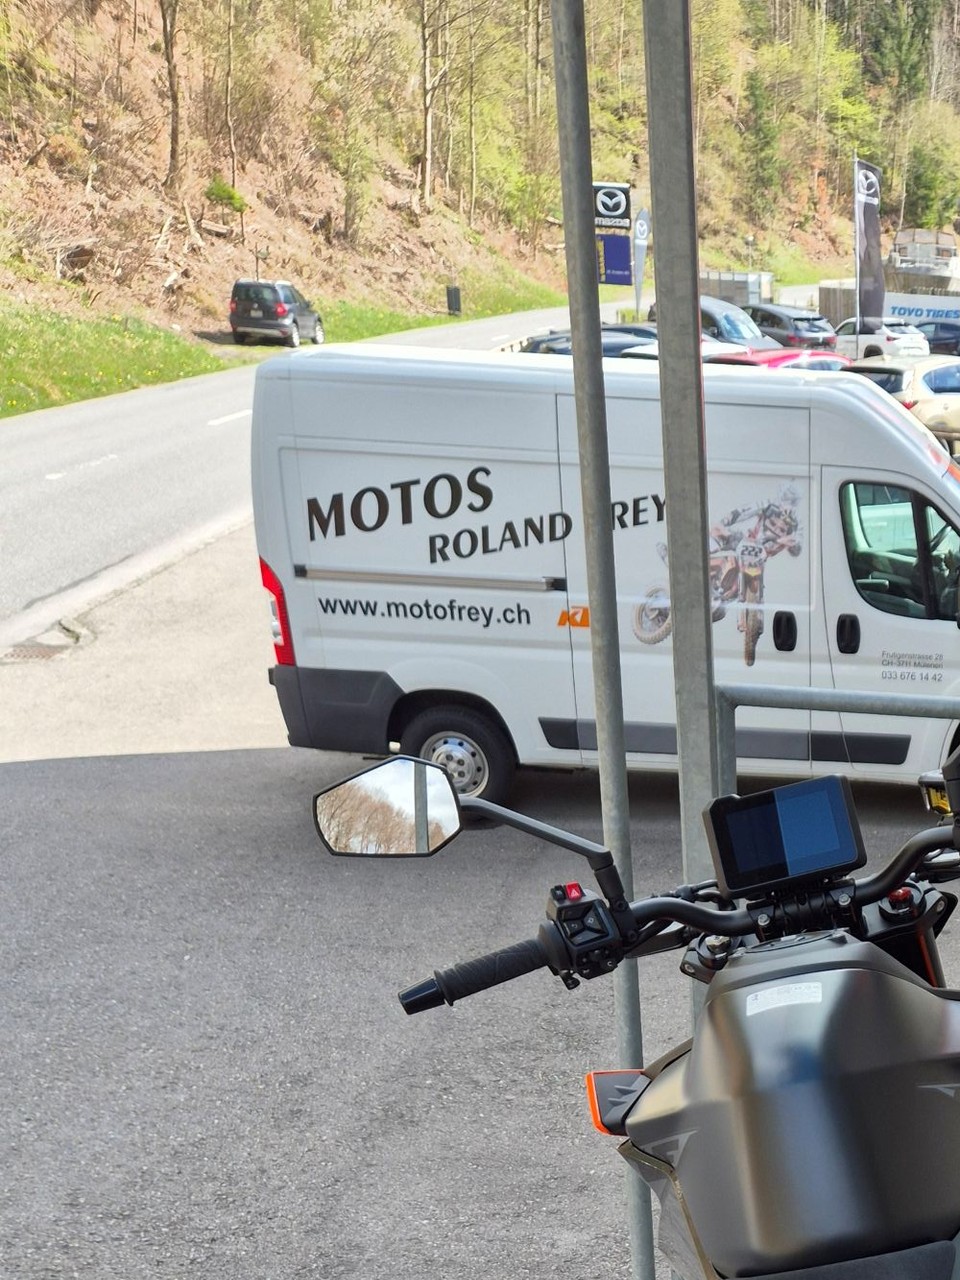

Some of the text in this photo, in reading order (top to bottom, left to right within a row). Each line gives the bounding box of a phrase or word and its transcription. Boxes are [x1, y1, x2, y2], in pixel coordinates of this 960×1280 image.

[890, 306, 924, 317] TOYO
[306, 466, 494, 542] MOTOS
[429, 493, 666, 564] ROLAND REY
[318, 597, 532, 628] www.motofrey.ch
[881, 671, 943, 682] 033 676 14 42
